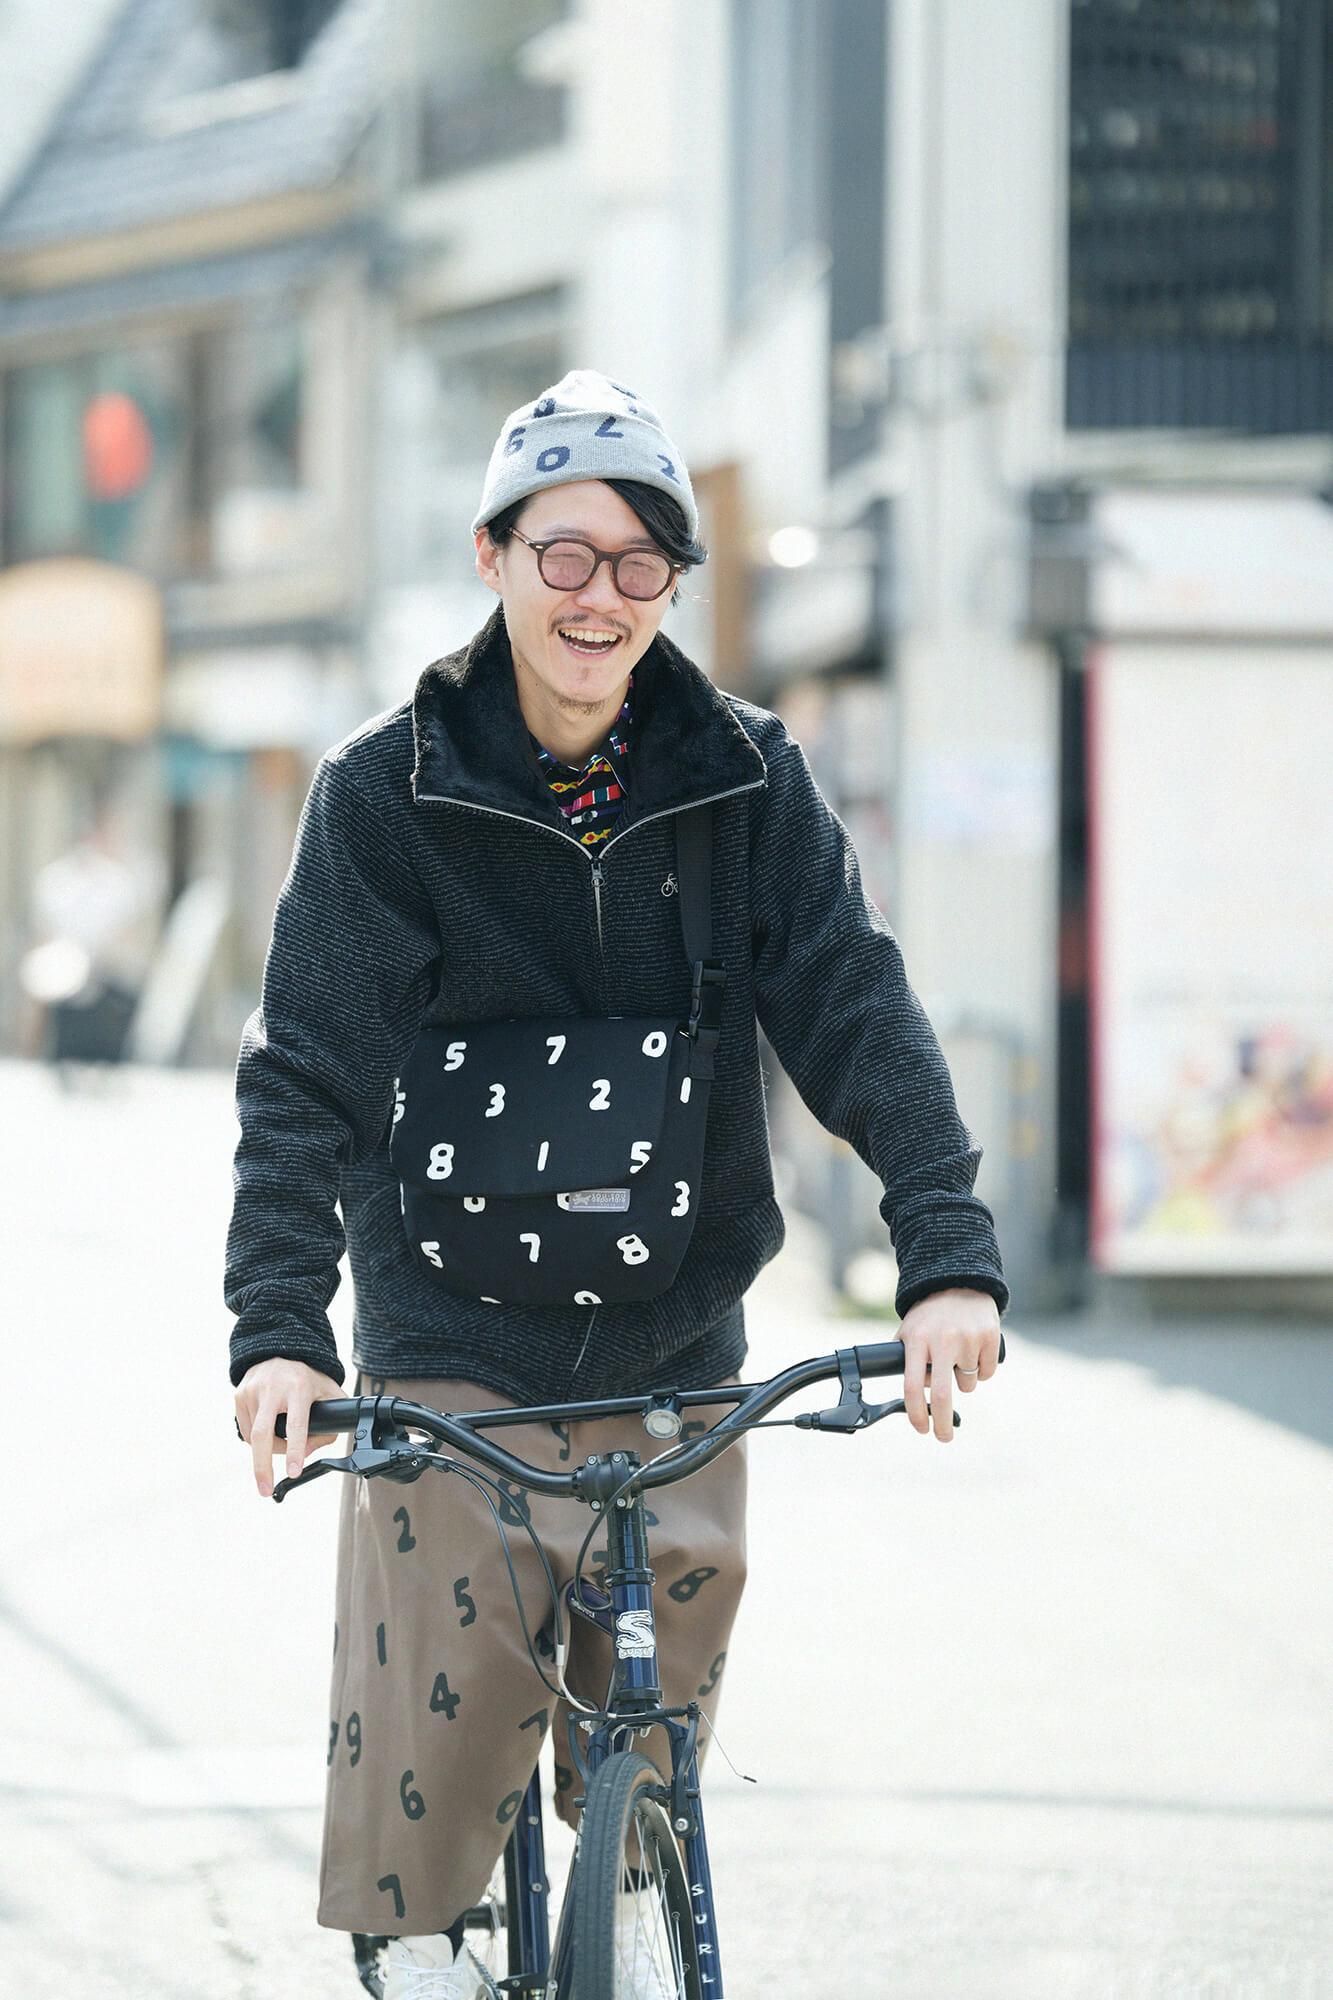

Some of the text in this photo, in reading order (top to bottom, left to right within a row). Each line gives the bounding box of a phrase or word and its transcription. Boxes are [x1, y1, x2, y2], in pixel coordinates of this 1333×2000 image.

[444, 1042, 467, 1071] 5
[546, 1035, 566, 1064] 7
[642, 1031, 667, 1057] 0
[485, 1083, 506, 1117] 3
[589, 1079, 611, 1111] 2
[680, 1077, 691, 1103] 1
[426, 1143, 454, 1180] 8
[537, 1141, 549, 1171] 1
[630, 1141, 652, 1174] 5
[671, 1181, 690, 1216] 3
[421, 1242, 444, 1268] 5
[519, 1233, 541, 1262] 7
[616, 1234, 650, 1265] 8
[393, 1506, 417, 1554] 2
[453, 1576, 477, 1628] 5
[667, 1566, 720, 1604] 8
[376, 1622, 387, 1667] 1
[429, 1672, 461, 1721] 4
[346, 1711, 362, 1768] 9
[400, 1770, 426, 1820] 6
[377, 1874, 406, 1919] 7
[691, 1883, 724, 2000] SURL
